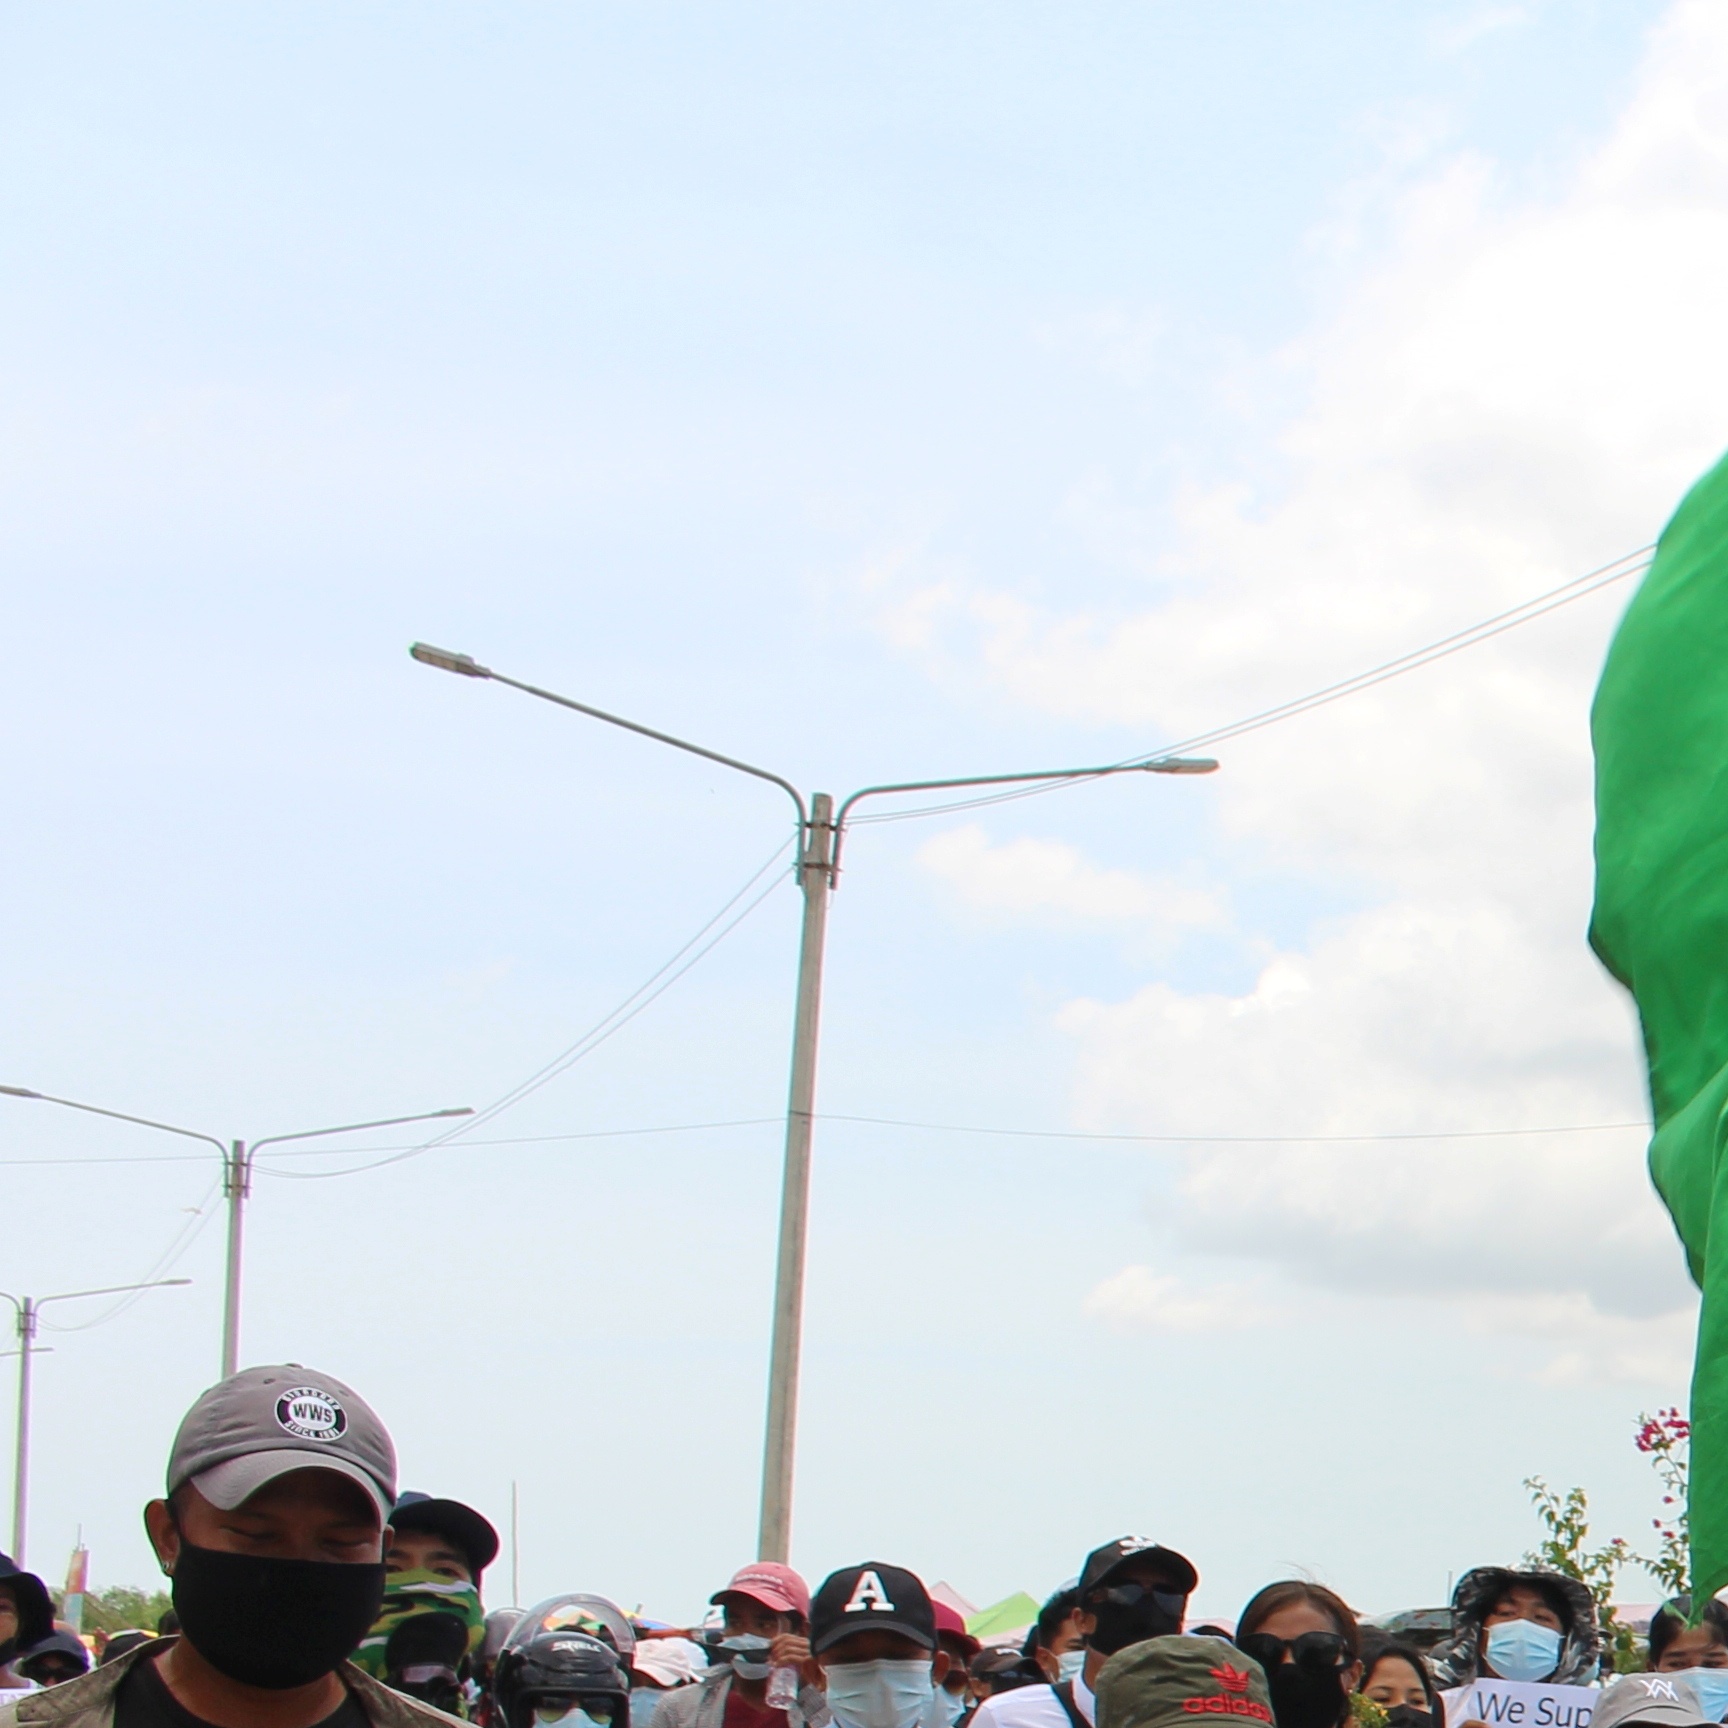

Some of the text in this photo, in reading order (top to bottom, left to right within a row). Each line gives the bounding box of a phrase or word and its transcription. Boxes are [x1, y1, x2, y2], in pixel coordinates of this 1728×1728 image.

[293, 1403, 332, 1423] WWS
[845, 1570, 895, 1613] A
[1477, 1691, 1525, 1724] We
